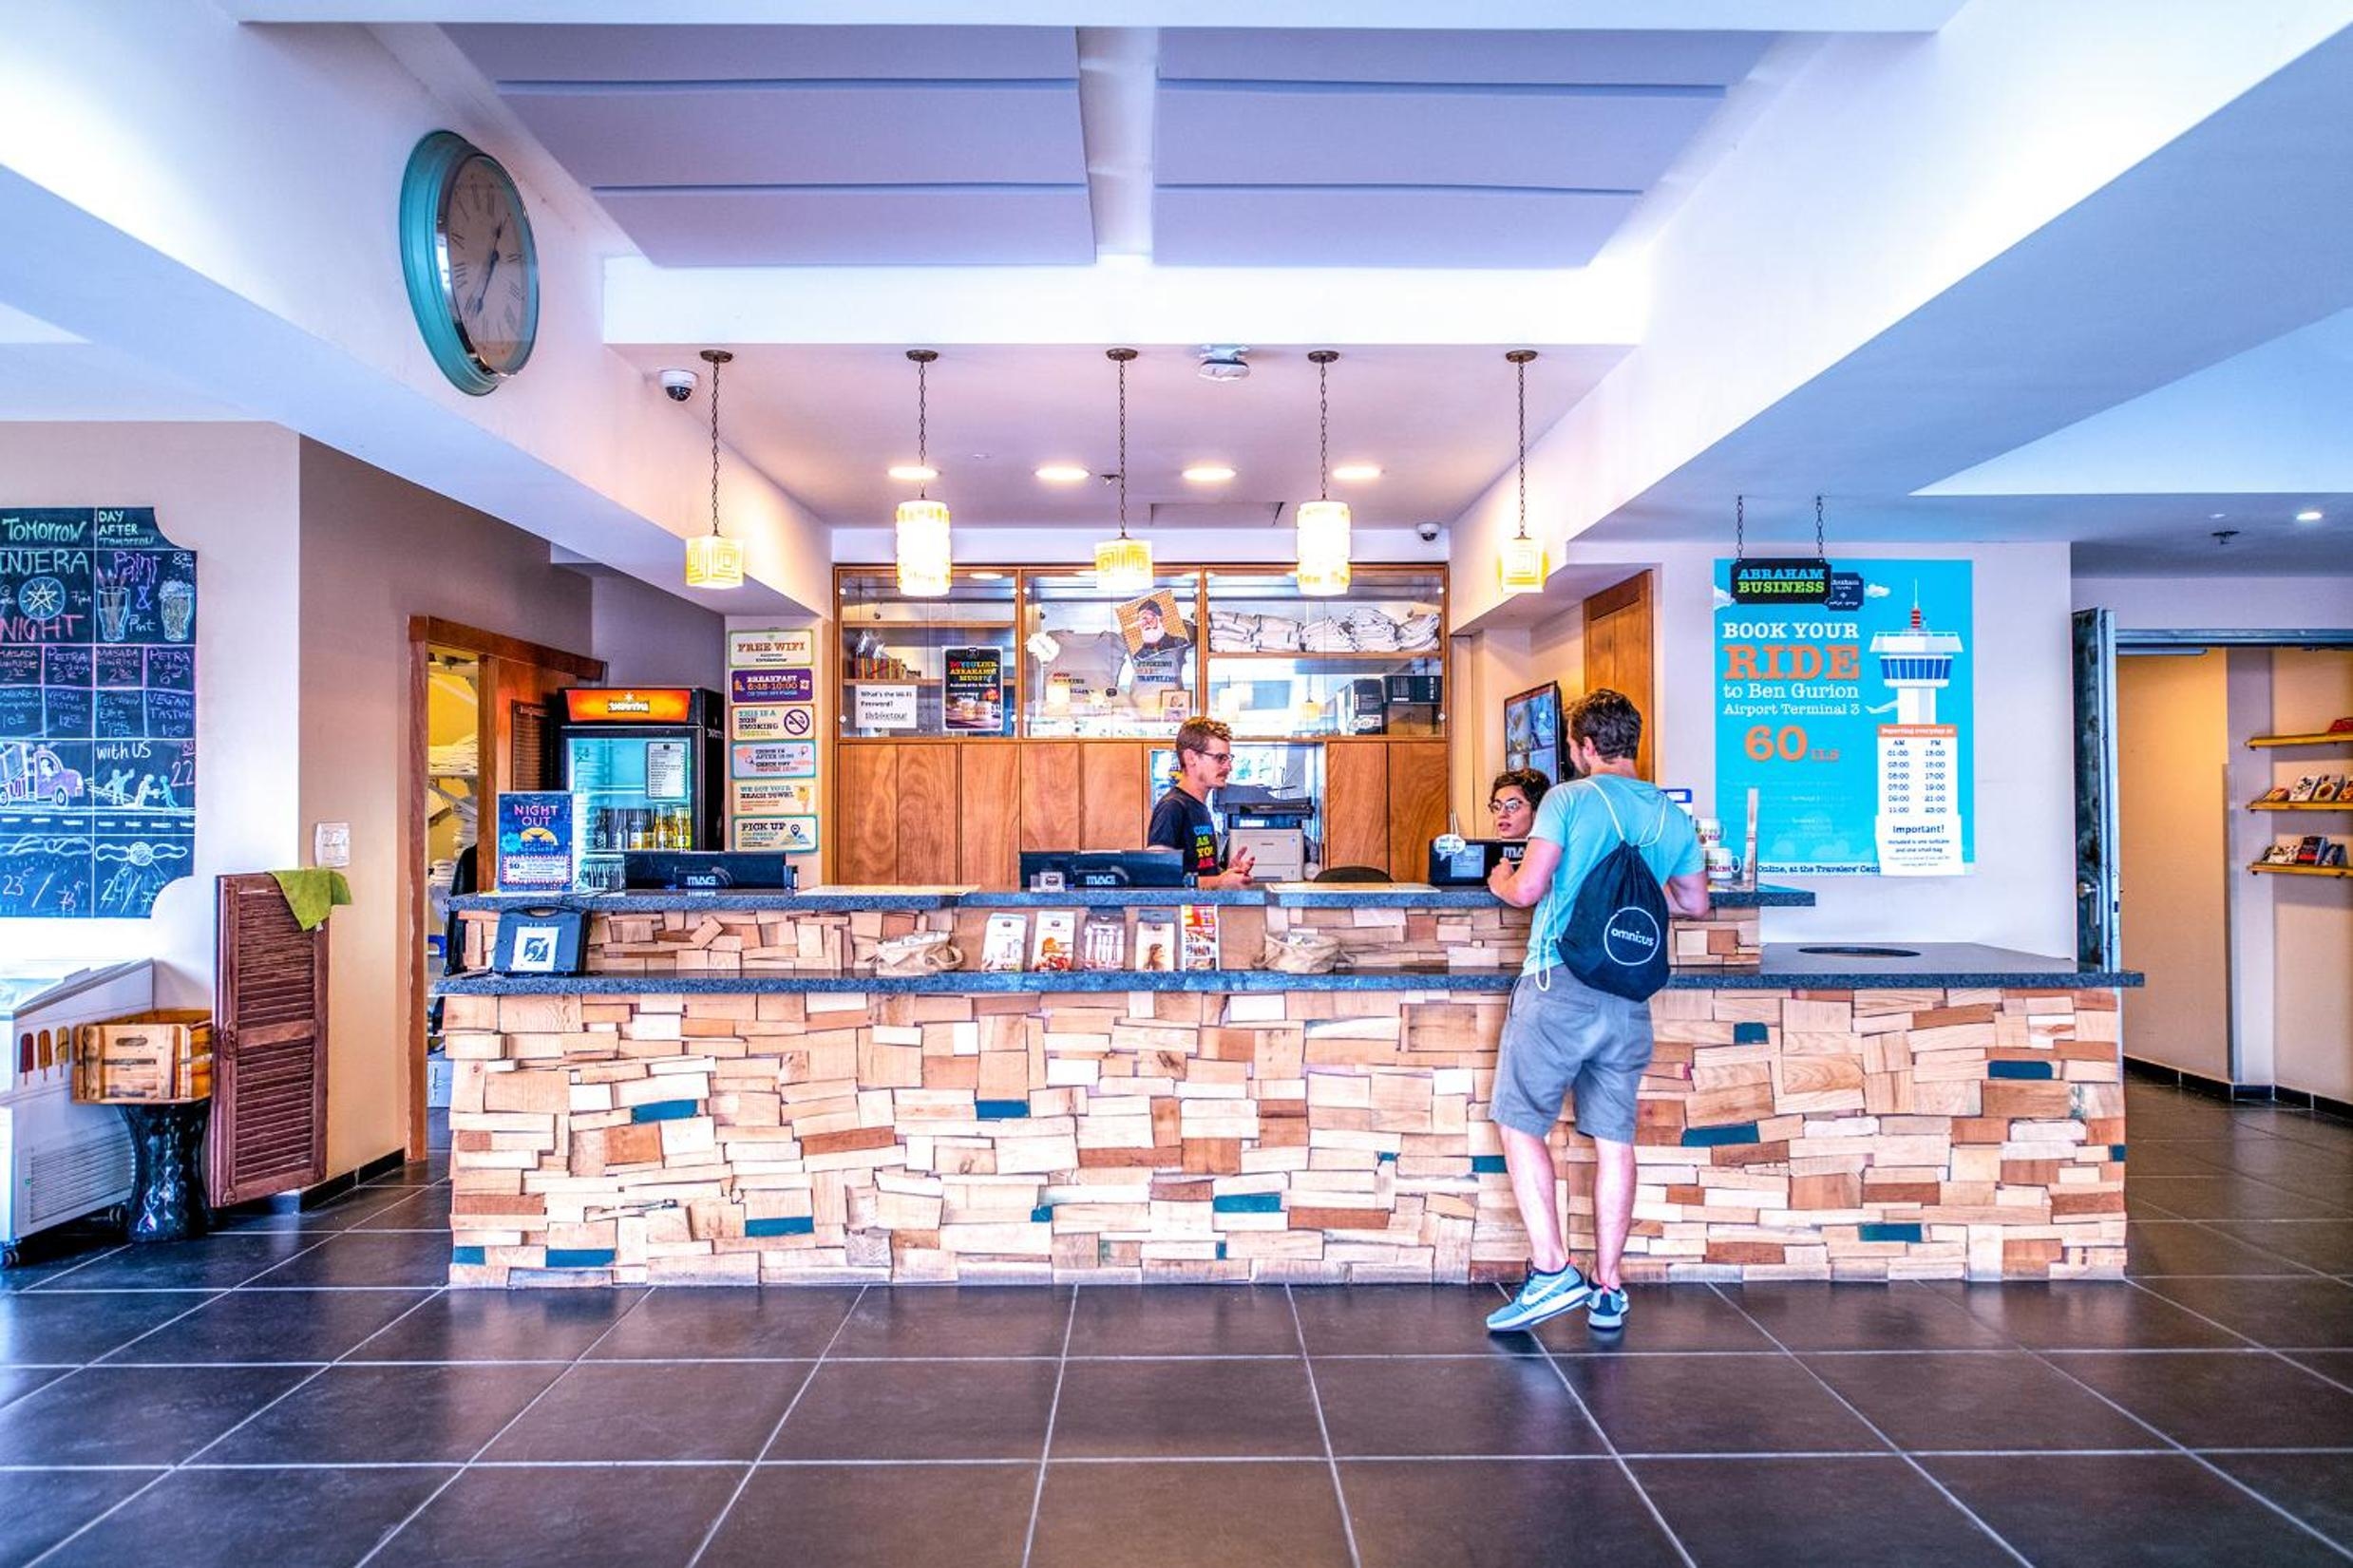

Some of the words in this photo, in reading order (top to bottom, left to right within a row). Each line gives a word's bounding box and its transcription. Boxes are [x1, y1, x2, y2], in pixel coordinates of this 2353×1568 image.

[98, 510, 123, 522] DAY
[98, 524, 139, 536] AFTER
[0, 550, 89, 576] INJERA
[1737, 569, 1825, 579] ABRAHAM
[1737, 580, 1825, 594] BUSINESS
[0, 614, 85, 642] NIGHT
[1722, 622, 1788, 639] BOOK
[1793, 623, 1860, 639] YOUR
[737, 642, 771, 652] FREE
[149, 648, 190, 663] PETRA
[1723, 645, 1861, 681] RIDE
[1723, 684, 1743, 698] to
[1748, 684, 1786, 698] Ben
[1791, 683, 1859, 699] Gurion
[1723, 704, 1778, 717] Airport
[1781, 704, 1846, 715] Terminal
[1850, 704, 1860, 715] 3
[97, 742, 129, 760] with
[132, 741, 152, 758] US
[1744, 725, 1808, 762] 60
[514, 804, 559, 816] NIGHT
[522, 816, 551, 826] OUT
[1892, 824, 1945, 835] Important!
